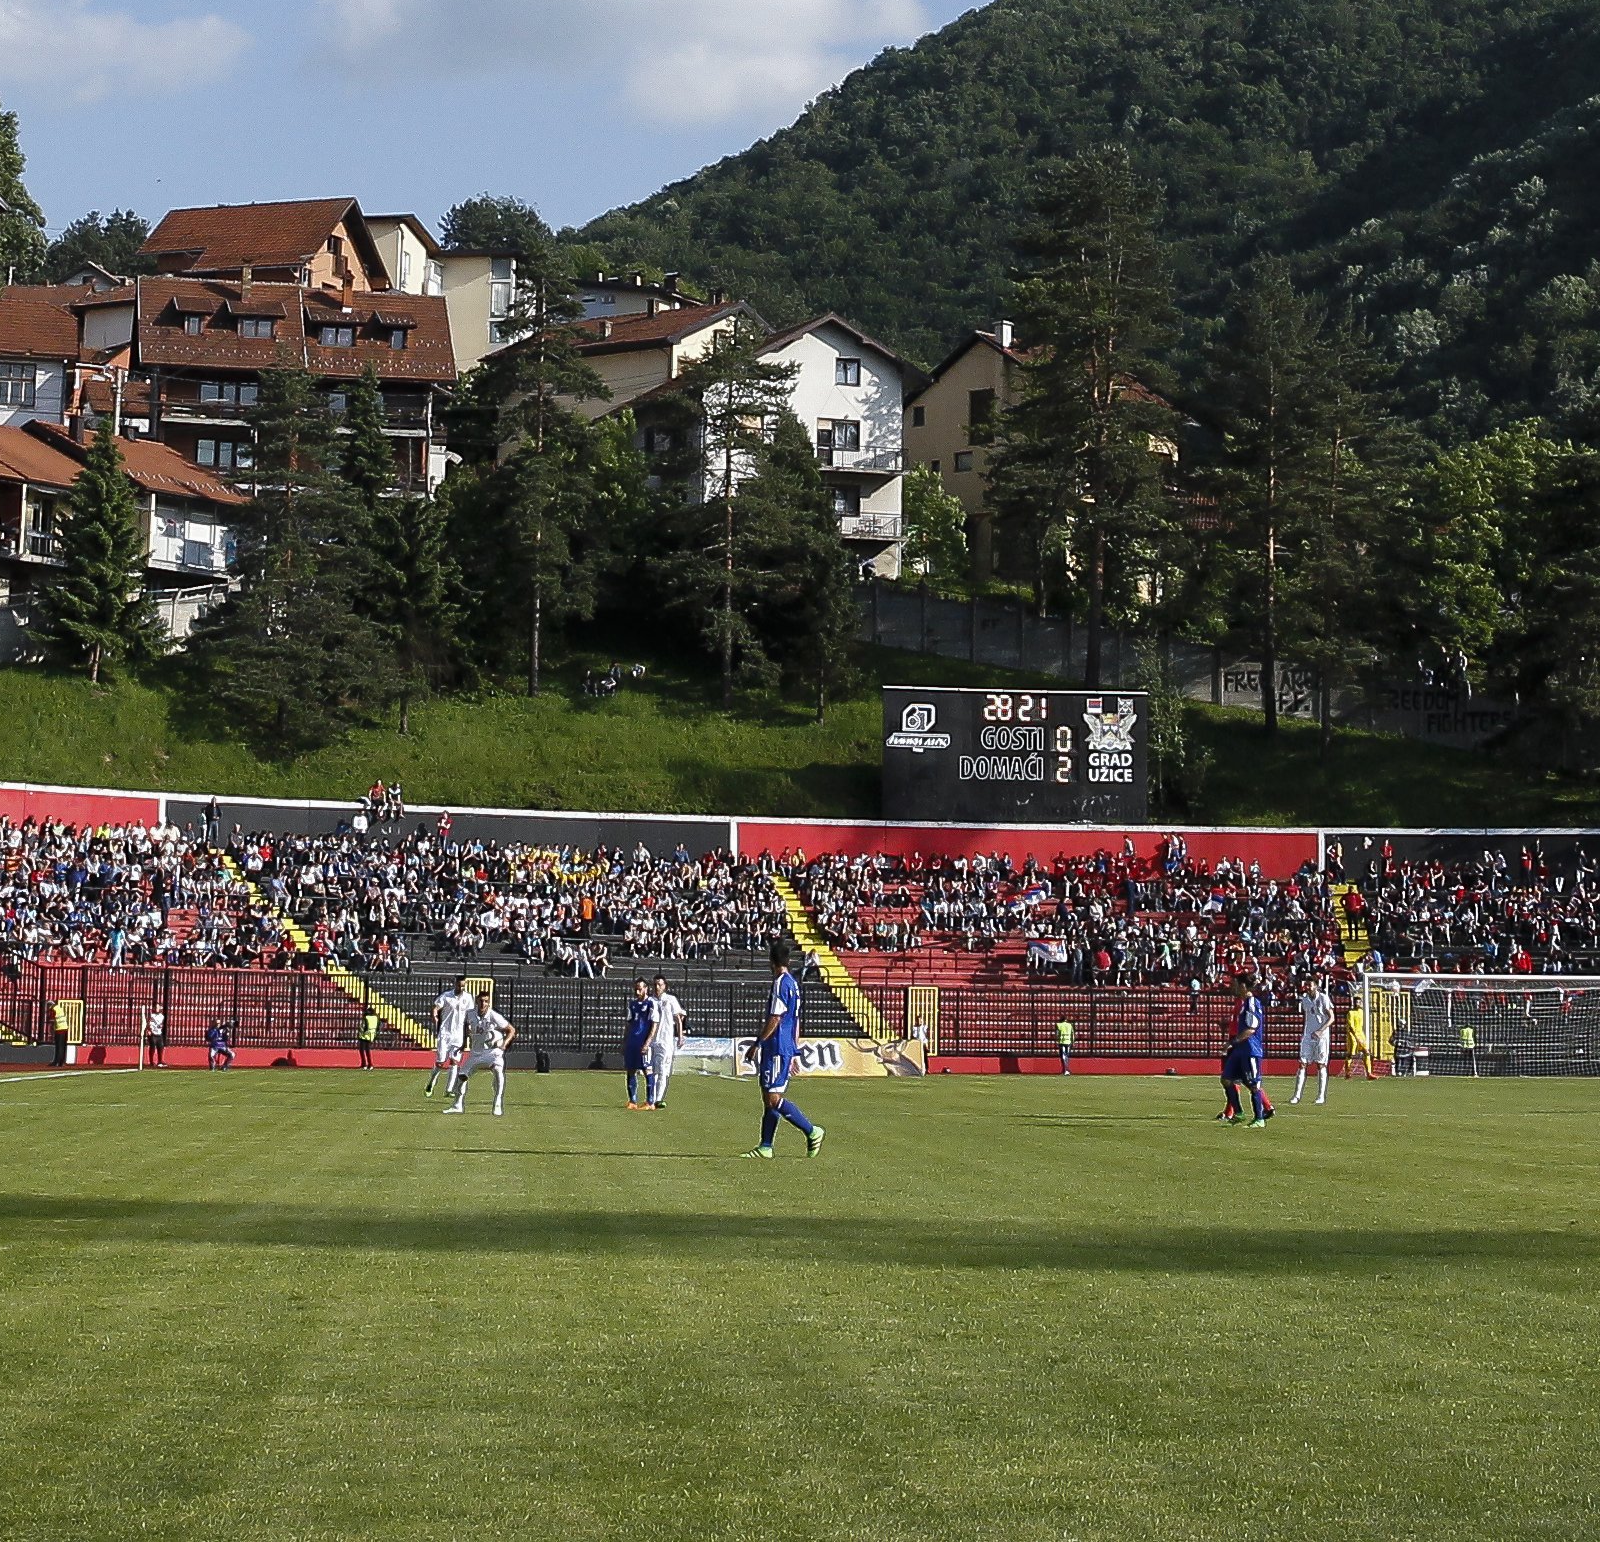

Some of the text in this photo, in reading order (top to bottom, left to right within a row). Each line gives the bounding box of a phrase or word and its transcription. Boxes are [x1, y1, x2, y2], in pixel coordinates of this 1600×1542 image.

[984, 695, 1047, 722] 28 21
[980, 726, 1072, 752] GOSTI 0
[1056, 756, 1072, 782] 2
[1088, 753, 1133, 767] GRAD
[1088, 766, 1133, 783] UŽICE
